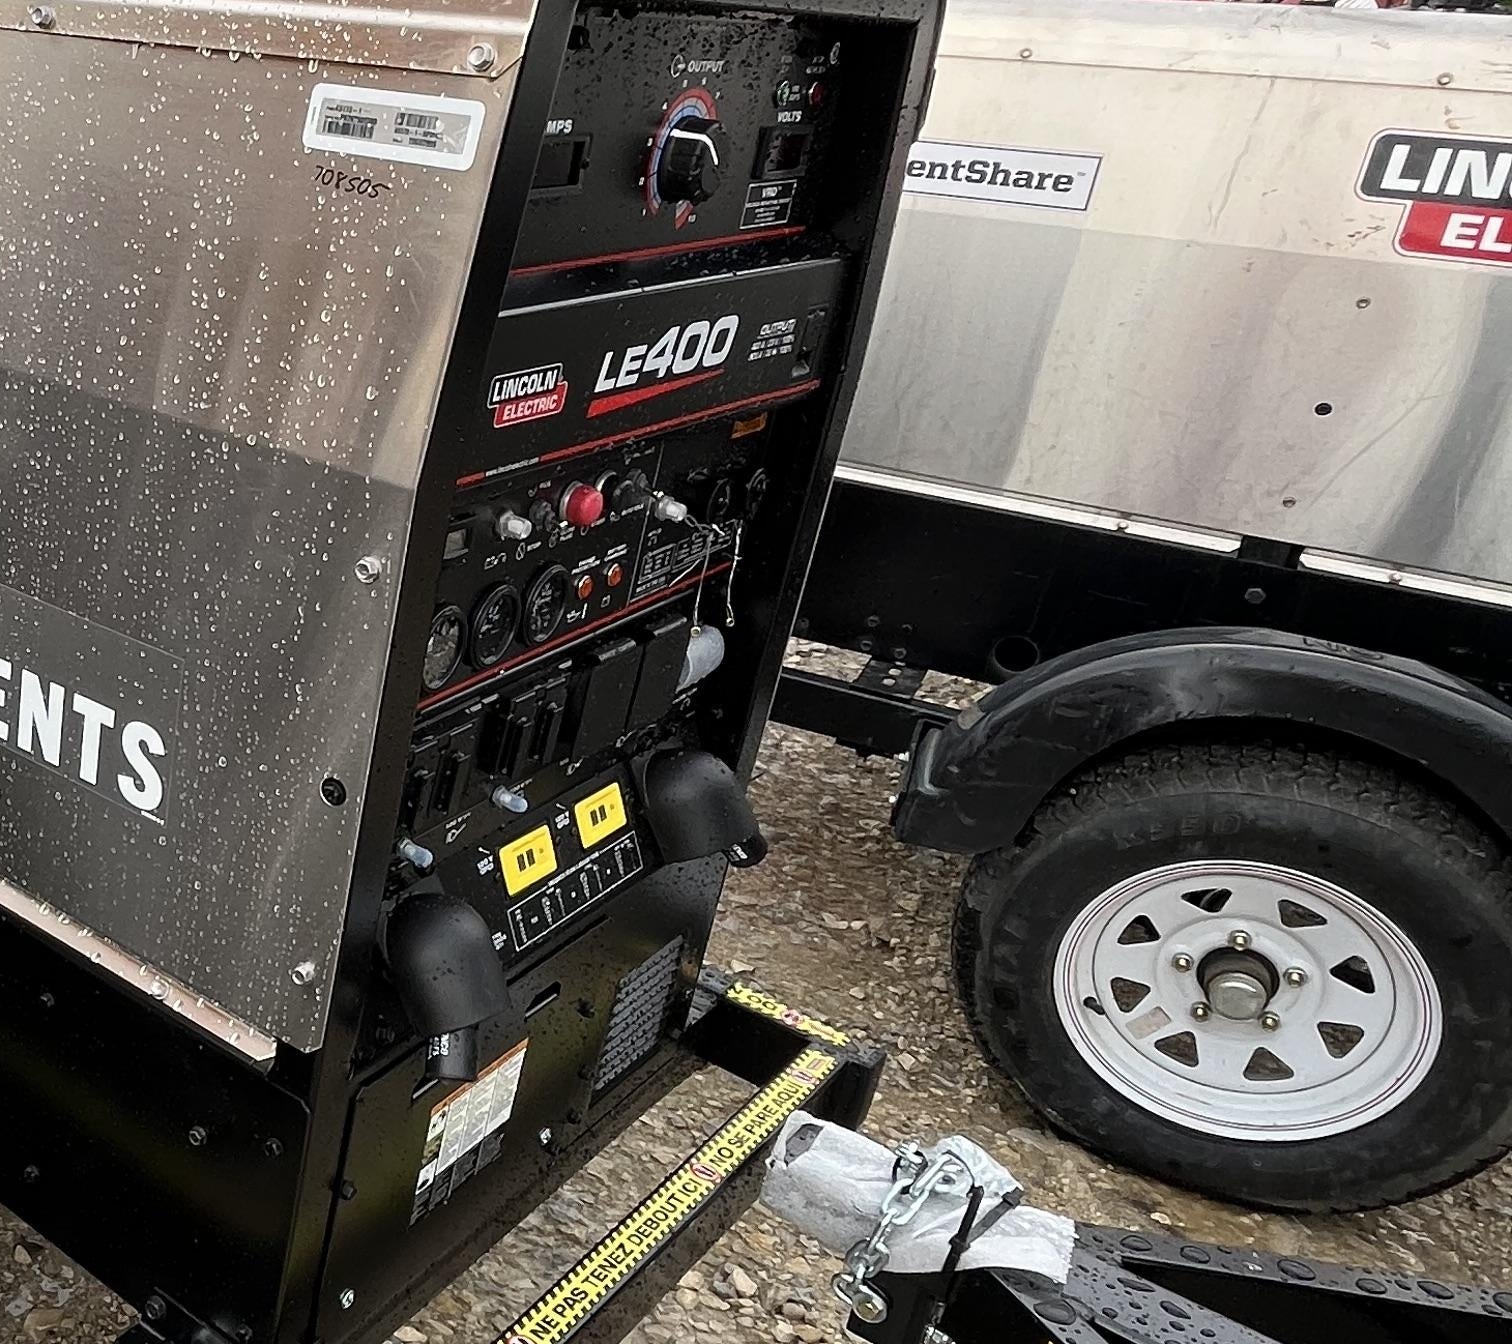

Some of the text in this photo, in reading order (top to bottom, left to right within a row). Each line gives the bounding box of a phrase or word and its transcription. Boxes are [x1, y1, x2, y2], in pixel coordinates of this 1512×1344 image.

[688, 59, 725, 73] OUTPUT
[546, 119, 573, 133] MPS
[777, 110, 802, 123] VOLTS
[906, 159, 1074, 193] entShare
[1379, 143, 1512, 200] LIN
[1439, 212, 1512, 253] EL
[593, 315, 739, 393] LE400
[492, 369, 558, 402] LINCOLN
[502, 393, 559, 421] ELECTRIC
[530, 1318, 556, 1341] NE
[556, 1287, 589, 1320] PAS
[587, 1243, 634, 1289] TENEZ
[628, 1193, 683, 1247] DEBOUT
[680, 1179, 702, 1198] ICI
[709, 1146, 734, 1168] NO
[729, 1131, 751, 1150] SE
[745, 1106, 776, 1137] PARE
